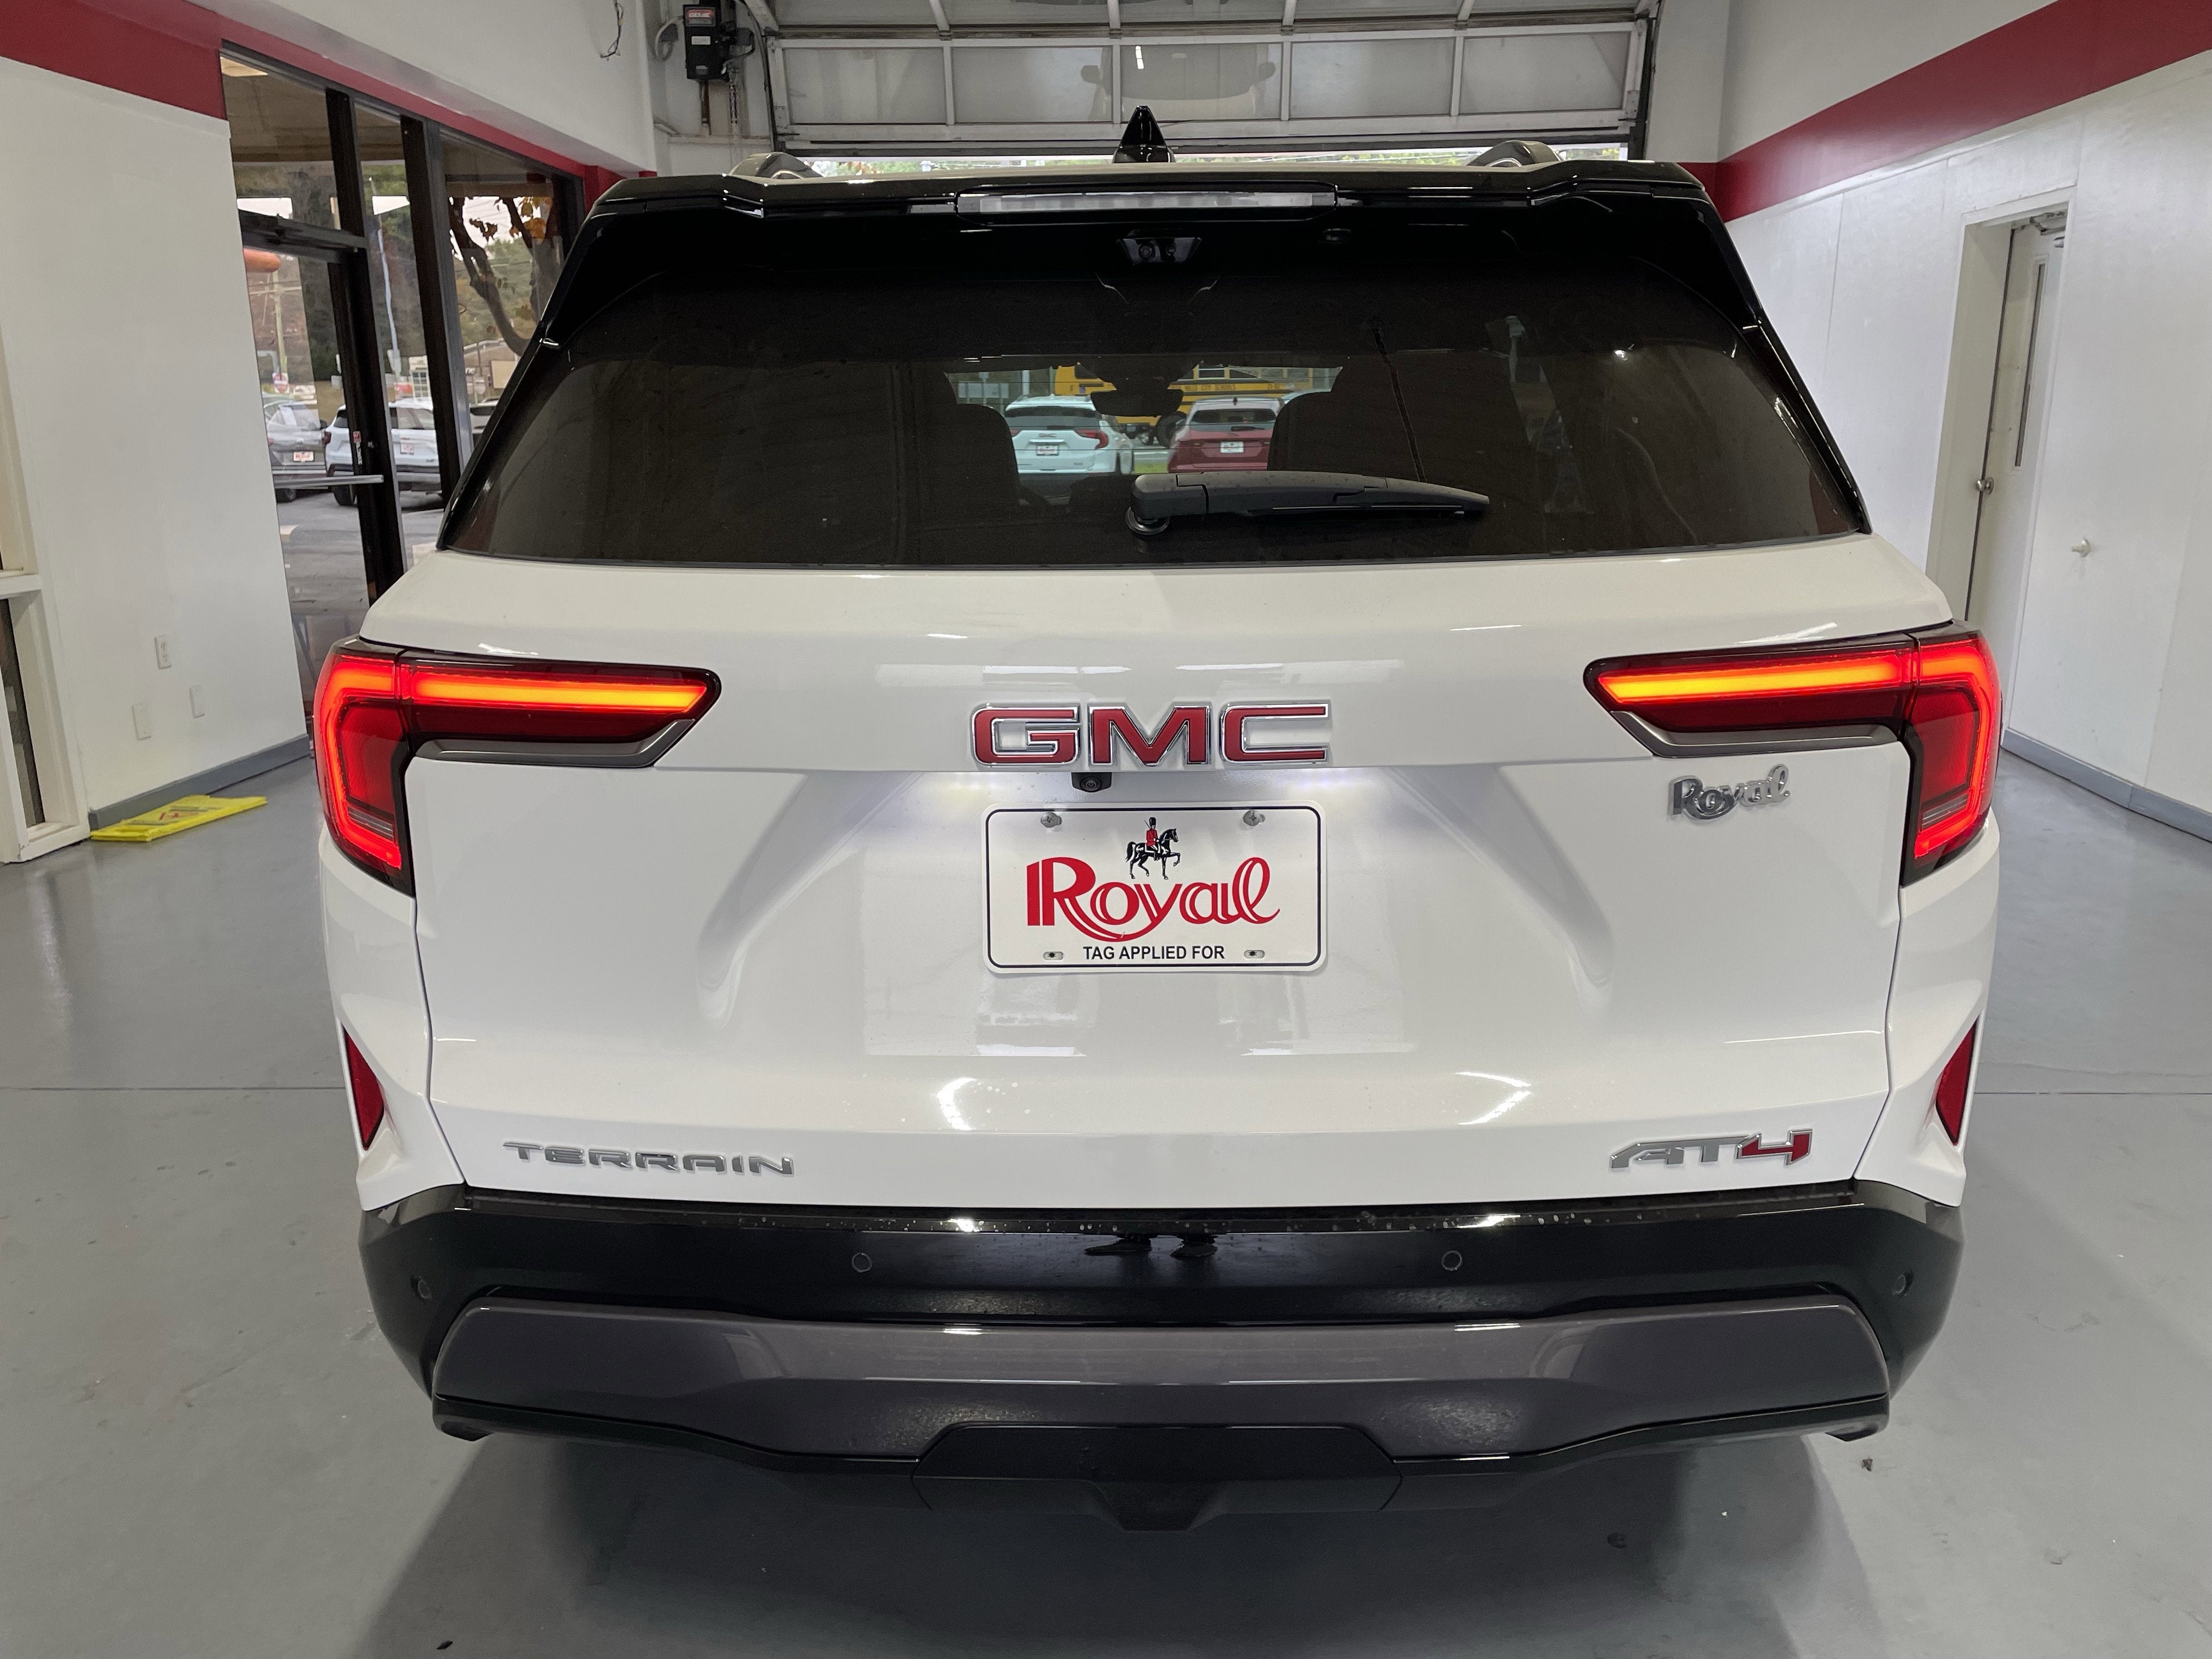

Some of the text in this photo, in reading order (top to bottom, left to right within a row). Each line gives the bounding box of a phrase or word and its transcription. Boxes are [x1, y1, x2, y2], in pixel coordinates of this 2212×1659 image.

[972, 701, 1329, 766] GMC
[1668, 764, 1790, 820] Royal
[1026, 857, 1280, 942] Royal
[1083, 945, 1225, 960] TAG APPLIED FOR
[503, 1142, 794, 1175] TERRAIN
[1610, 1128, 1813, 1169] AT4
